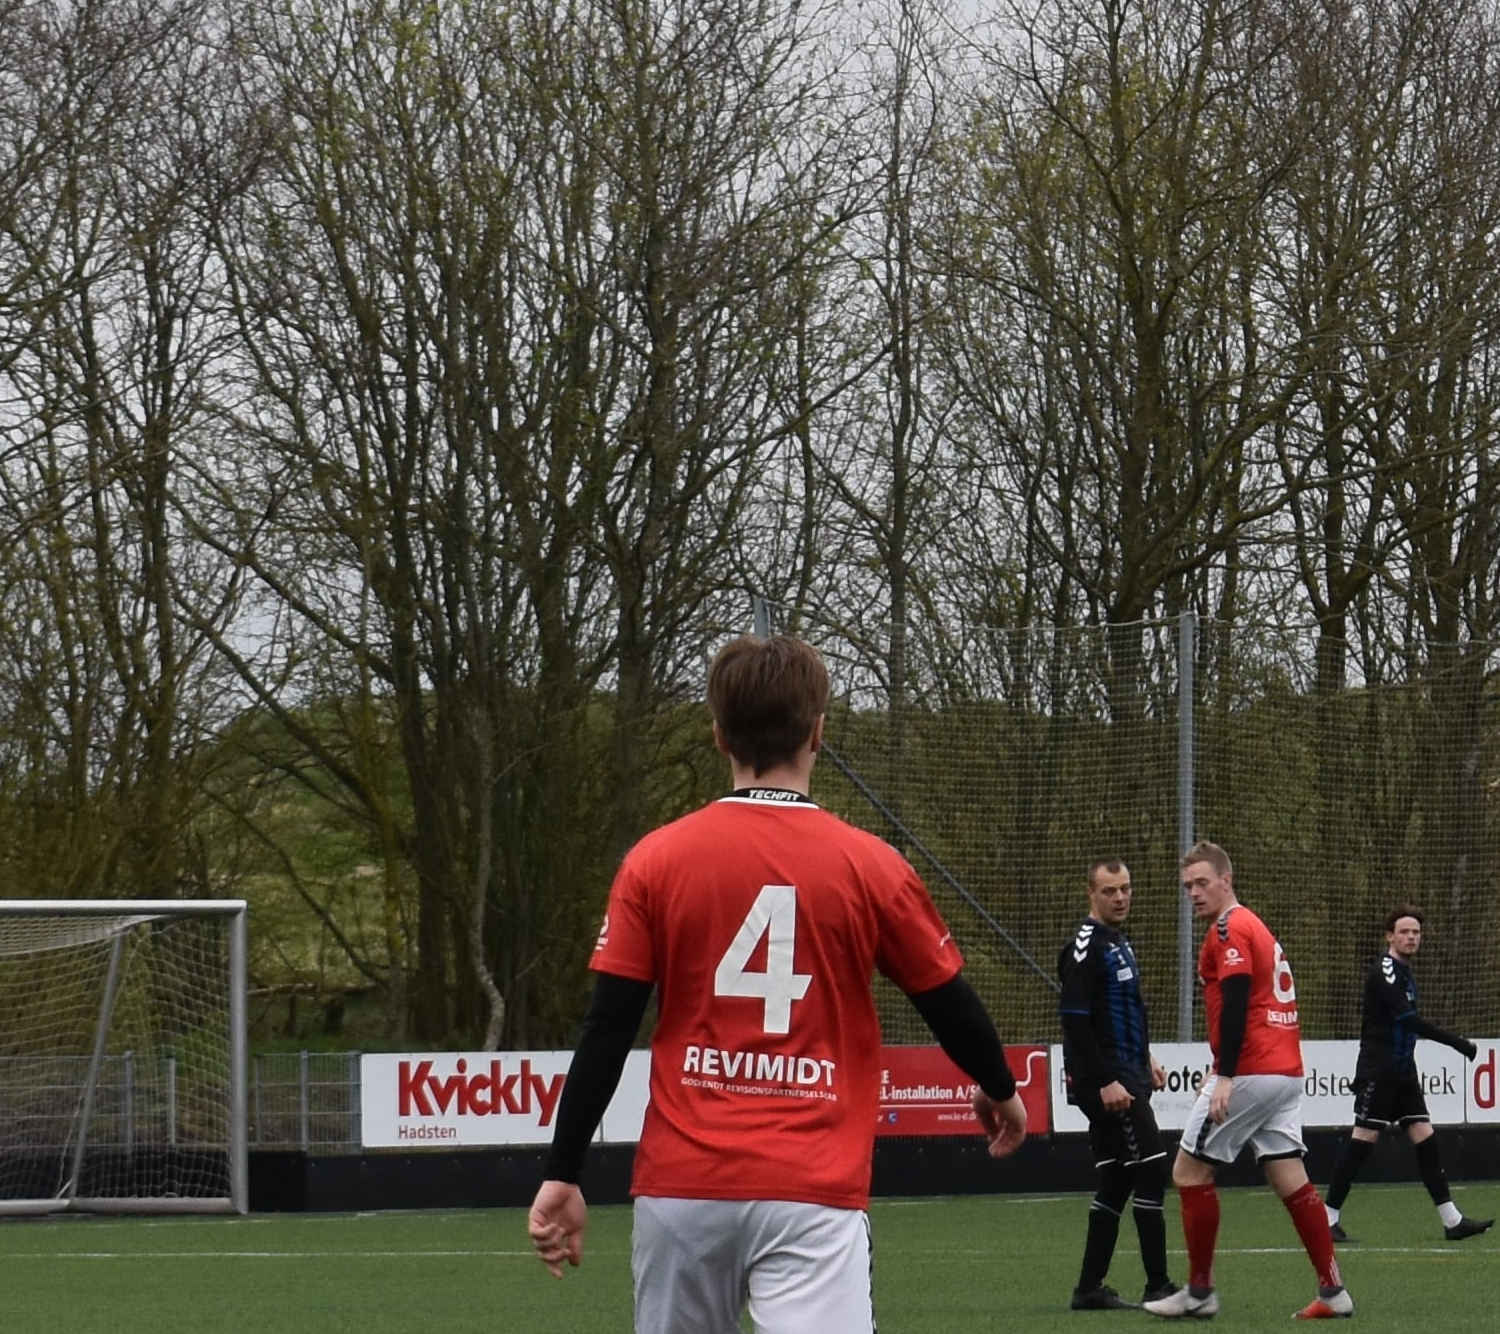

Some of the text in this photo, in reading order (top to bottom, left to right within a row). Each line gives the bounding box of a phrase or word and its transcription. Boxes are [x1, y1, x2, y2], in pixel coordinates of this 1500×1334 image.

[749, 789, 801, 801] TECHFIT
[714, 884, 814, 1034] 4
[683, 1045, 836, 1087] REVIMIDT
[398, 1058, 568, 1127] Kvickly
[398, 1124, 458, 1139] Hadsten
